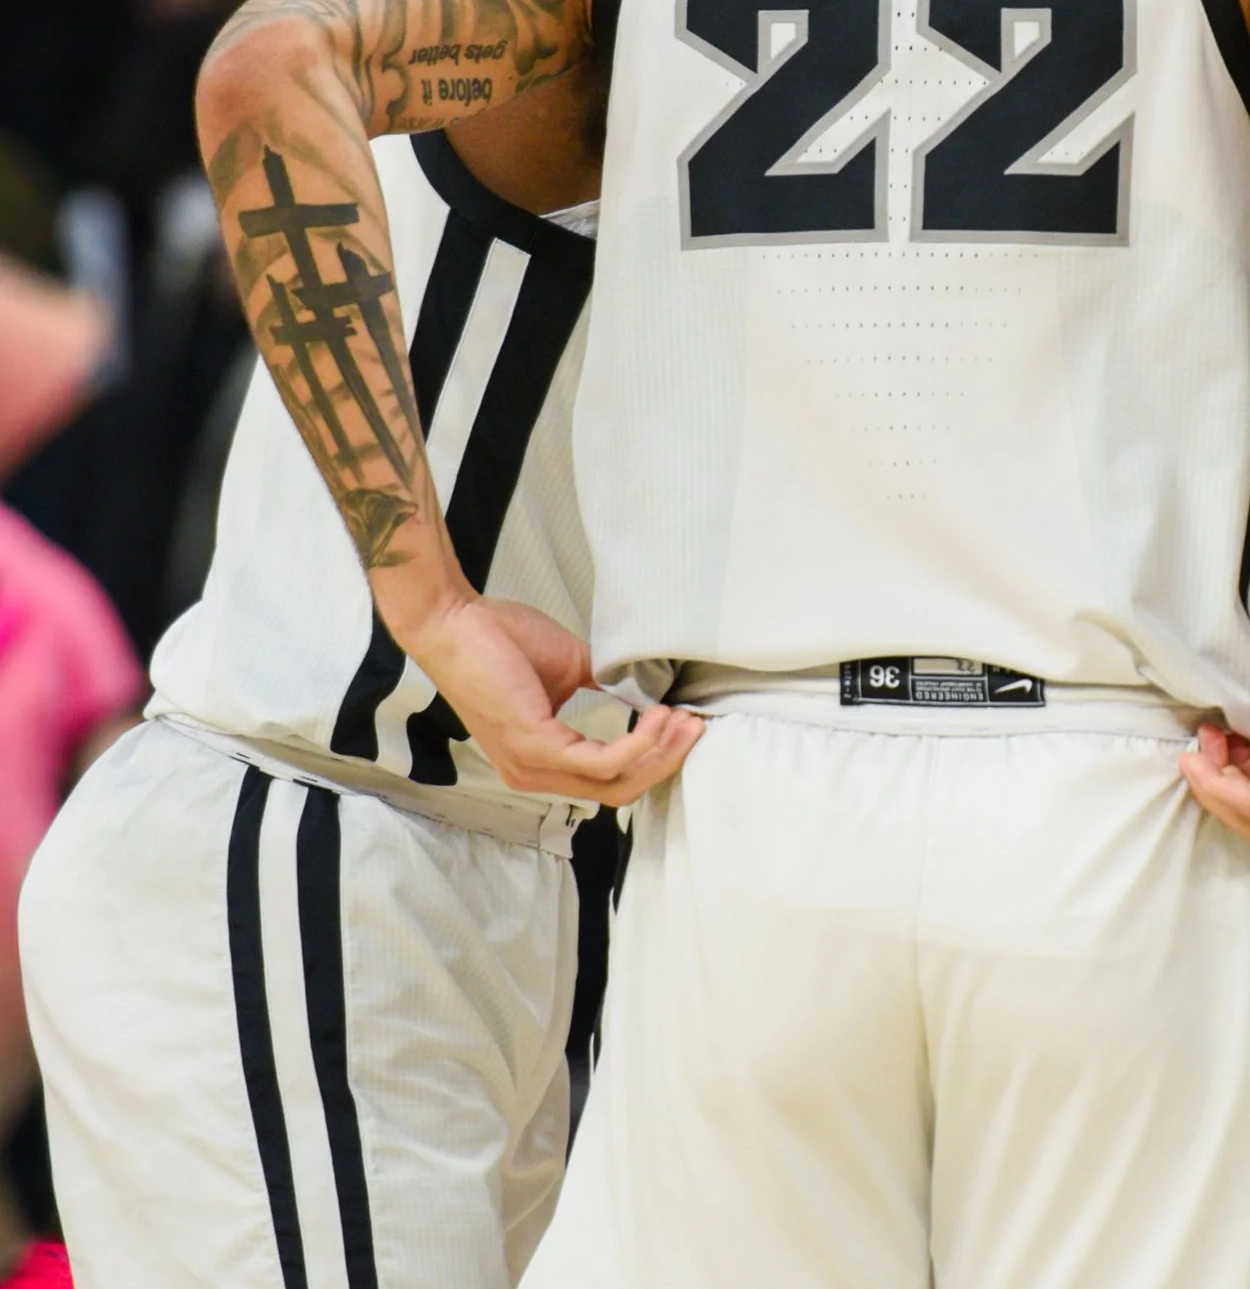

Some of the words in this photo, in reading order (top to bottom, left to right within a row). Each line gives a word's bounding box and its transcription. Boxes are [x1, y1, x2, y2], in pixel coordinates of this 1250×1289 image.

[408, 43, 461, 67] better
[462, 39, 510, 65] gets
[421, 78, 434, 105] it
[438, 77, 493, 105] before
[869, 664, 901, 689] 36
